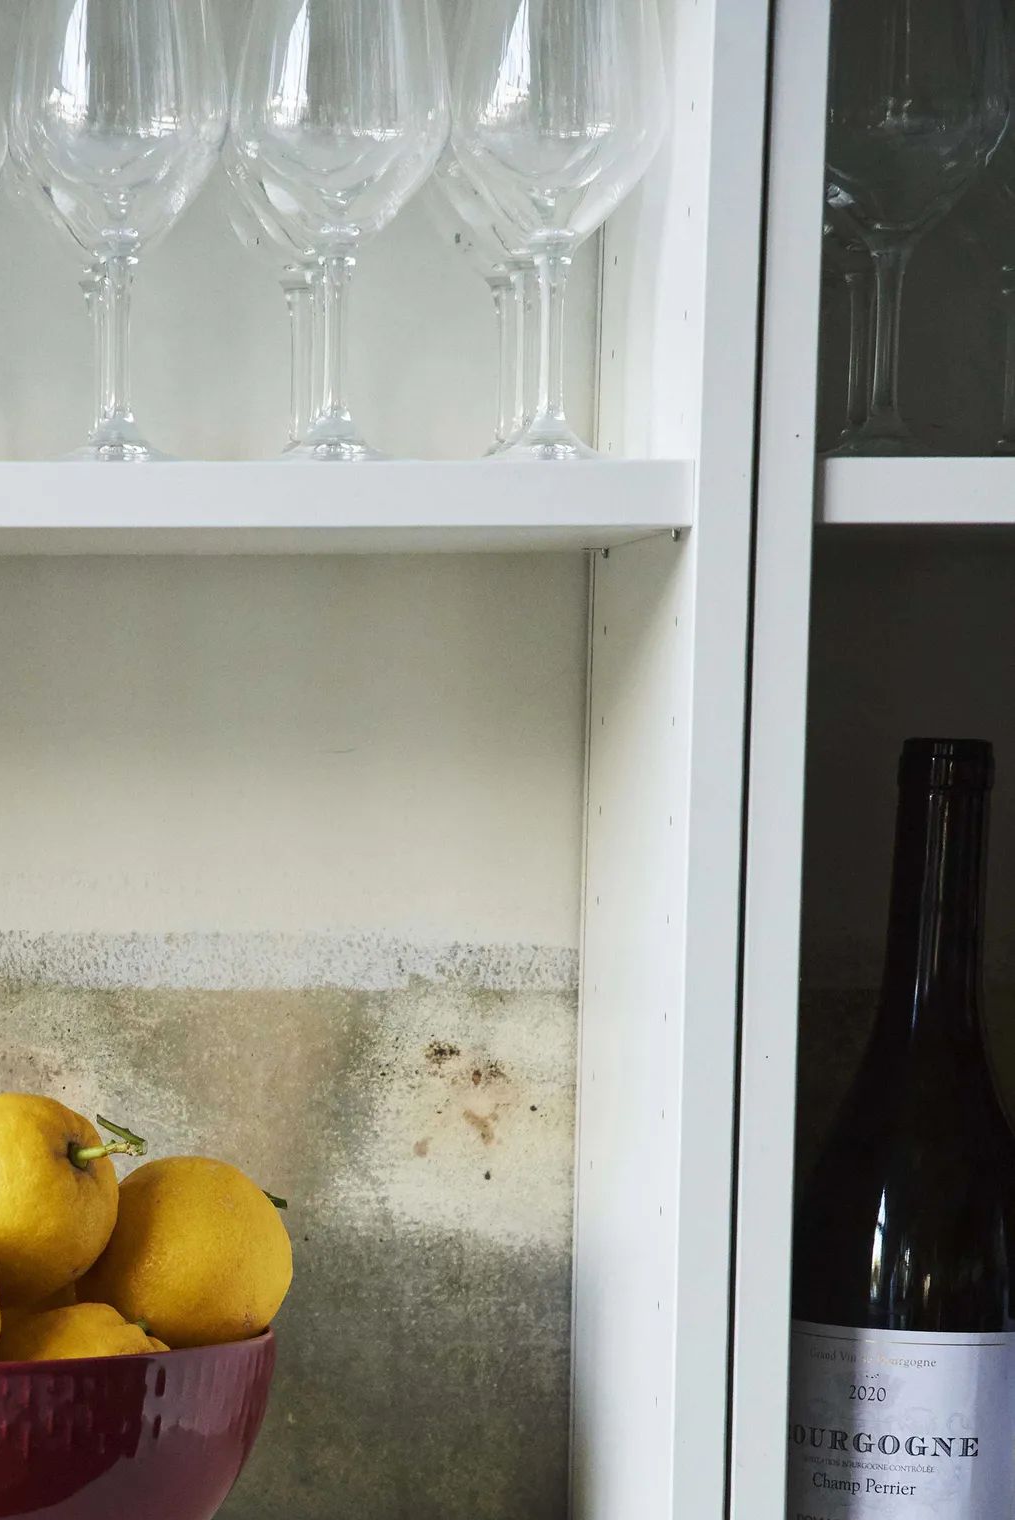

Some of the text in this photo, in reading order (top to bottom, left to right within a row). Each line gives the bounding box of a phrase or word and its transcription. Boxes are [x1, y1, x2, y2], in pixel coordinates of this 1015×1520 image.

[848, 1384, 887, 1403] 2020
[787, 1424, 979, 1458] OURGOGNE
[812, 1472, 917, 1496] Champ Perrier
